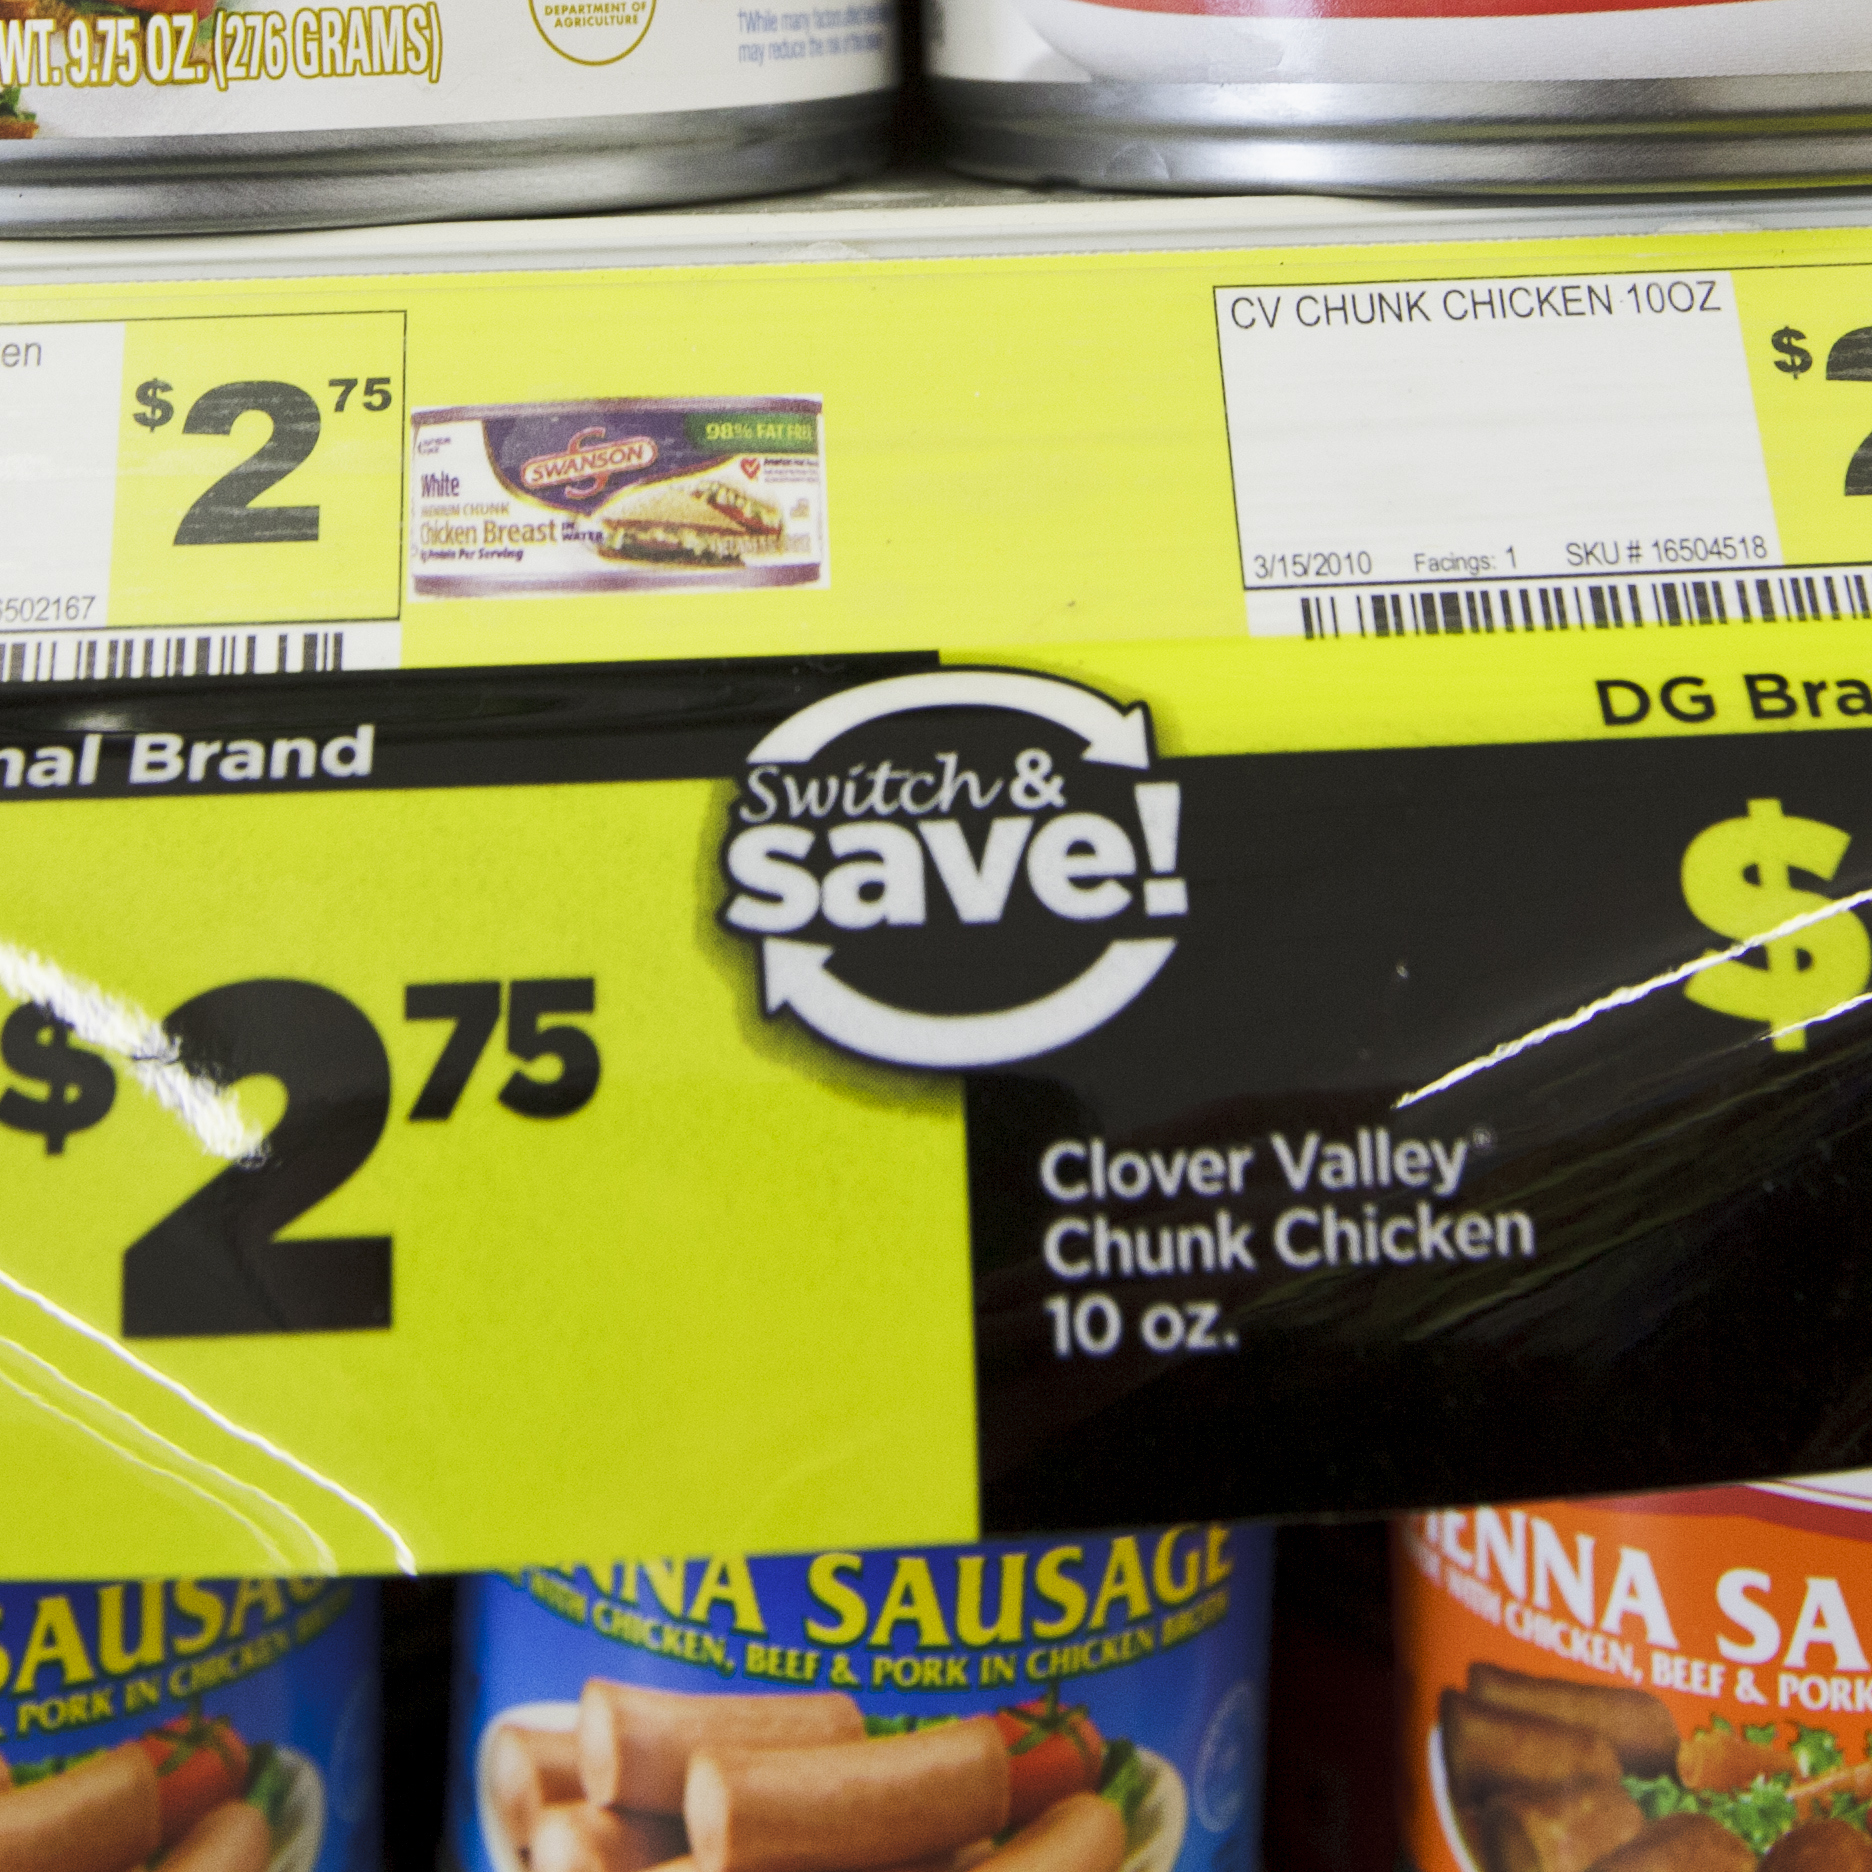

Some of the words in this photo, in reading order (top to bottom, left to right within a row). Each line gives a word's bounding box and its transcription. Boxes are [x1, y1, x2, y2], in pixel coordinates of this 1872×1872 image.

[544, 2, 626, 16] DEPARTMENT
[631, 1, 647, 12] OF
[554, 14, 639, 28] AGRICULTURE
[66, 15, 141, 89] 9.75
[143, 11, 208, 85] OZ.
[212, 9, 288, 91] (276
[292, 2, 443, 83] GRAMS)
[1230, 294, 1286, 329] CV
[1294, 291, 1432, 328] CHUNK
[1442, 284, 1614, 322] CHICKEN
[421, 471, 459, 498] White
[532, 445, 644, 482] SWANSON
[482, 519, 557, 544] Breast
[1253, 551, 1372, 579] 3/15/2010
[1413, 550, 1495, 576] Facings:
[1505, 546, 1517, 569] 1
[1565, 540, 1619, 568] SKU
[1625, 539, 1644, 564] #
[1650, 536, 1769, 564] 16504518
[1596, 680, 1723, 729] DG
[131, 725, 377, 785] Brand
[742, 754, 1002, 825] Switch
[1009, 748, 1066, 806] &
[726, 781, 1189, 932] save!
[1041, 1137, 1259, 1201] Clover
[1044, 1207, 1256, 1275] Chunk
[1274, 1204, 1533, 1263] Chicken
[1044, 1297, 1121, 1352] 10
[1140, 1300, 1240, 1352] oz.
[806, 1525, 1234, 1648] SAUSAGE
[1506, 1606, 1644, 1685] CHICKEN,
[1652, 1651, 1724, 1696] BEEF
[1736, 1670, 1767, 1703] &
